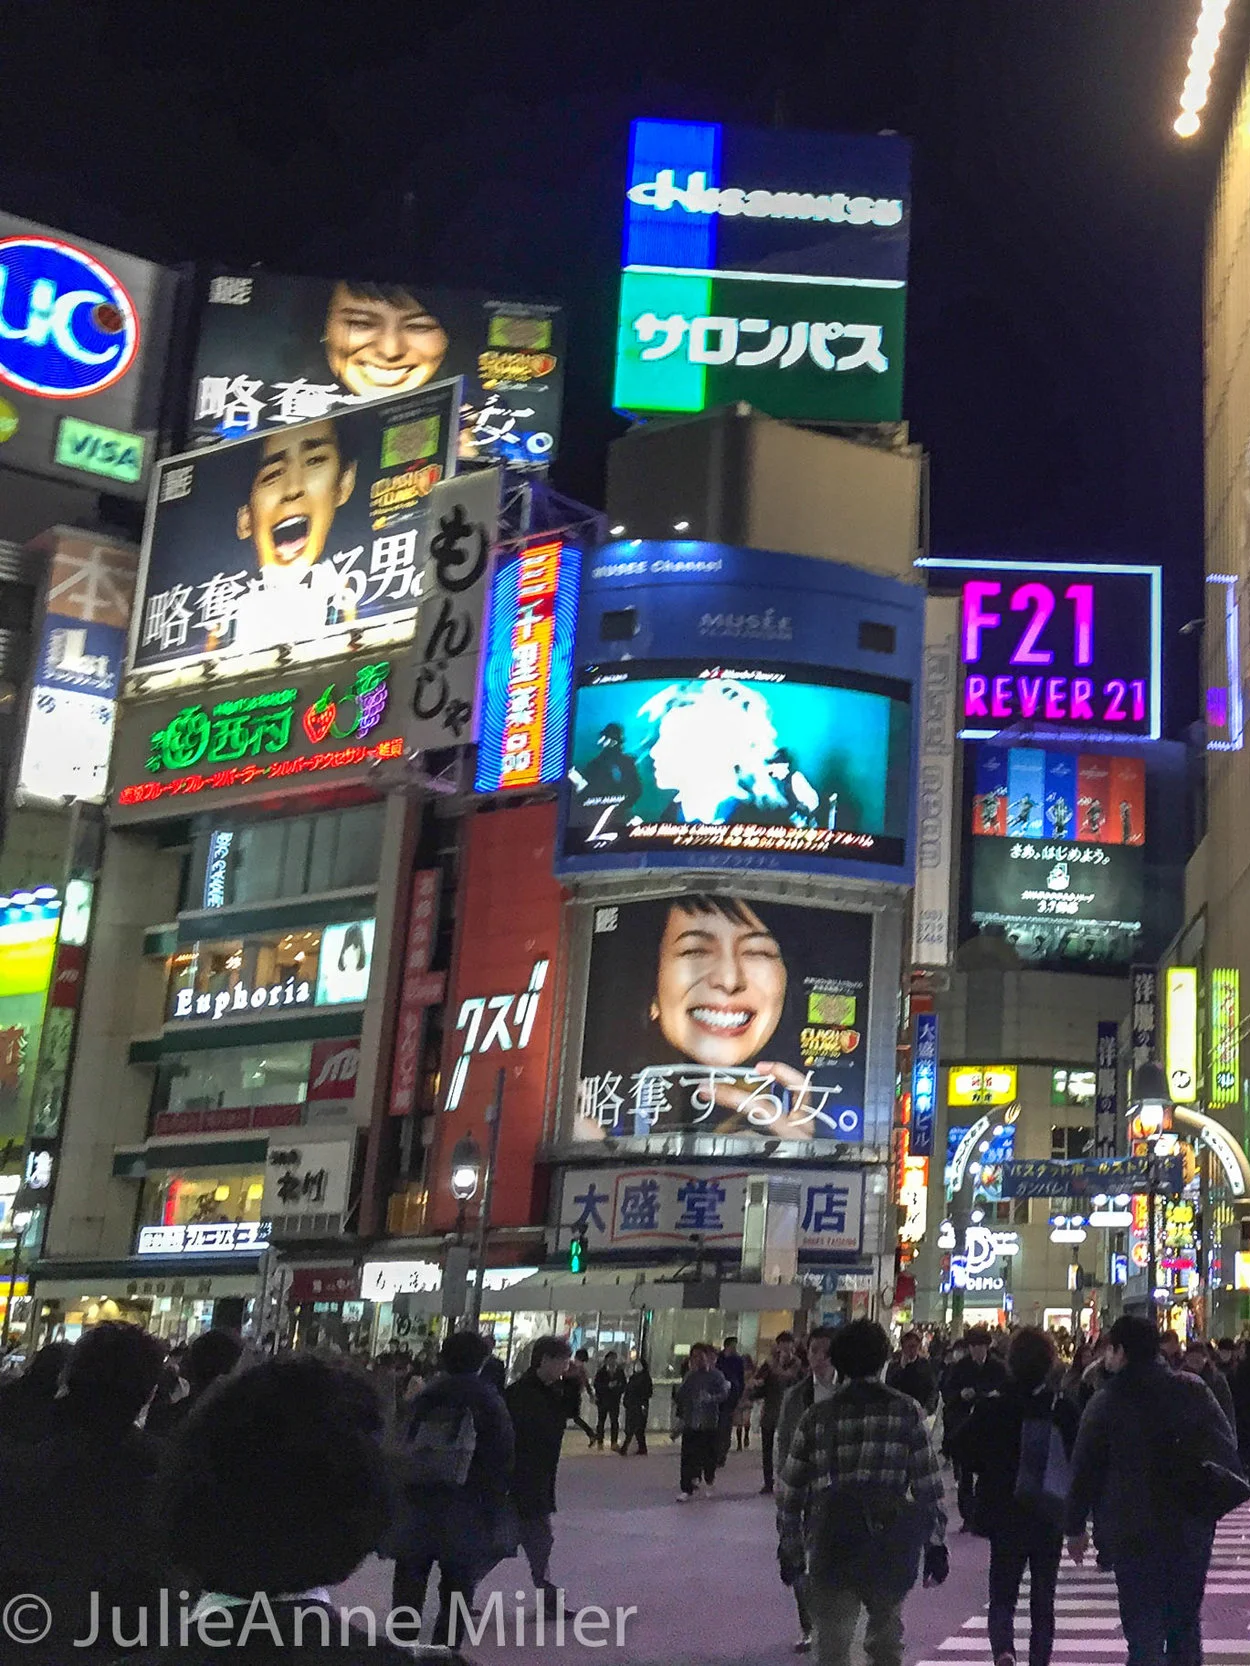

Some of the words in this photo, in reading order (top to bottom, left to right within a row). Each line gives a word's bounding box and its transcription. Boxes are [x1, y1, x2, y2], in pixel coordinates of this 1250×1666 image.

[627, 169, 903, 226] Hisamitsu
[633, 312, 889, 374] サロンパス
[71, 433, 138, 470] VISA
[411, 503, 489, 737] もんじゃ
[963, 580, 1094, 667] F21
[501, 551, 549, 774] 三千里薬品
[1102, 678, 1147, 722] 21
[208, 706, 296, 762] 西村
[174, 975, 310, 1020] Euphoria
[578, 1068, 869, 1132] 略奪する女。
[573, 1179, 849, 1234] 大盛堂店
